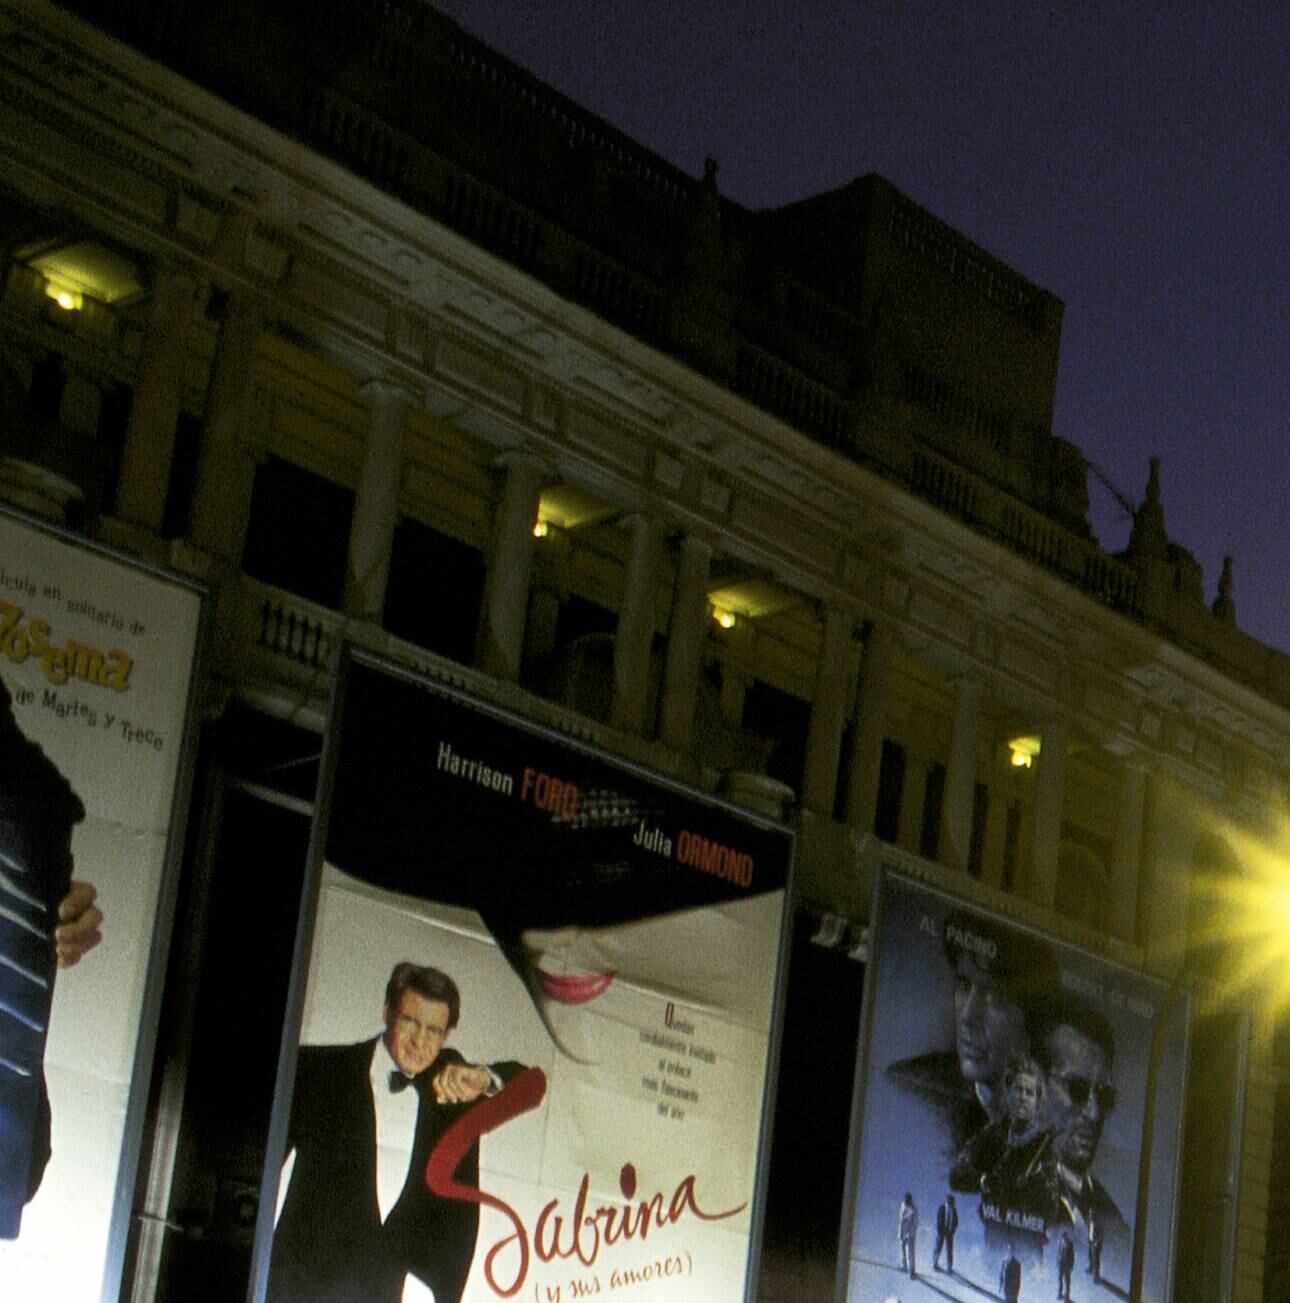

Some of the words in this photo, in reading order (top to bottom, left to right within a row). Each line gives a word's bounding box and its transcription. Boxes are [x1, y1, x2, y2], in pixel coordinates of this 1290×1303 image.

[43, 689, 97, 727] Martes
[104, 713, 116, 729] y
[122, 720, 164, 752] Trece
[437, 742, 514, 797] Harrison
[521, 767, 578, 820] FORD
[634, 821, 673, 857] Julia
[677, 830, 754, 889] ORMOND
[572, 1276, 601, 1298] sus
[611, 1250, 693, 1289] amores)
